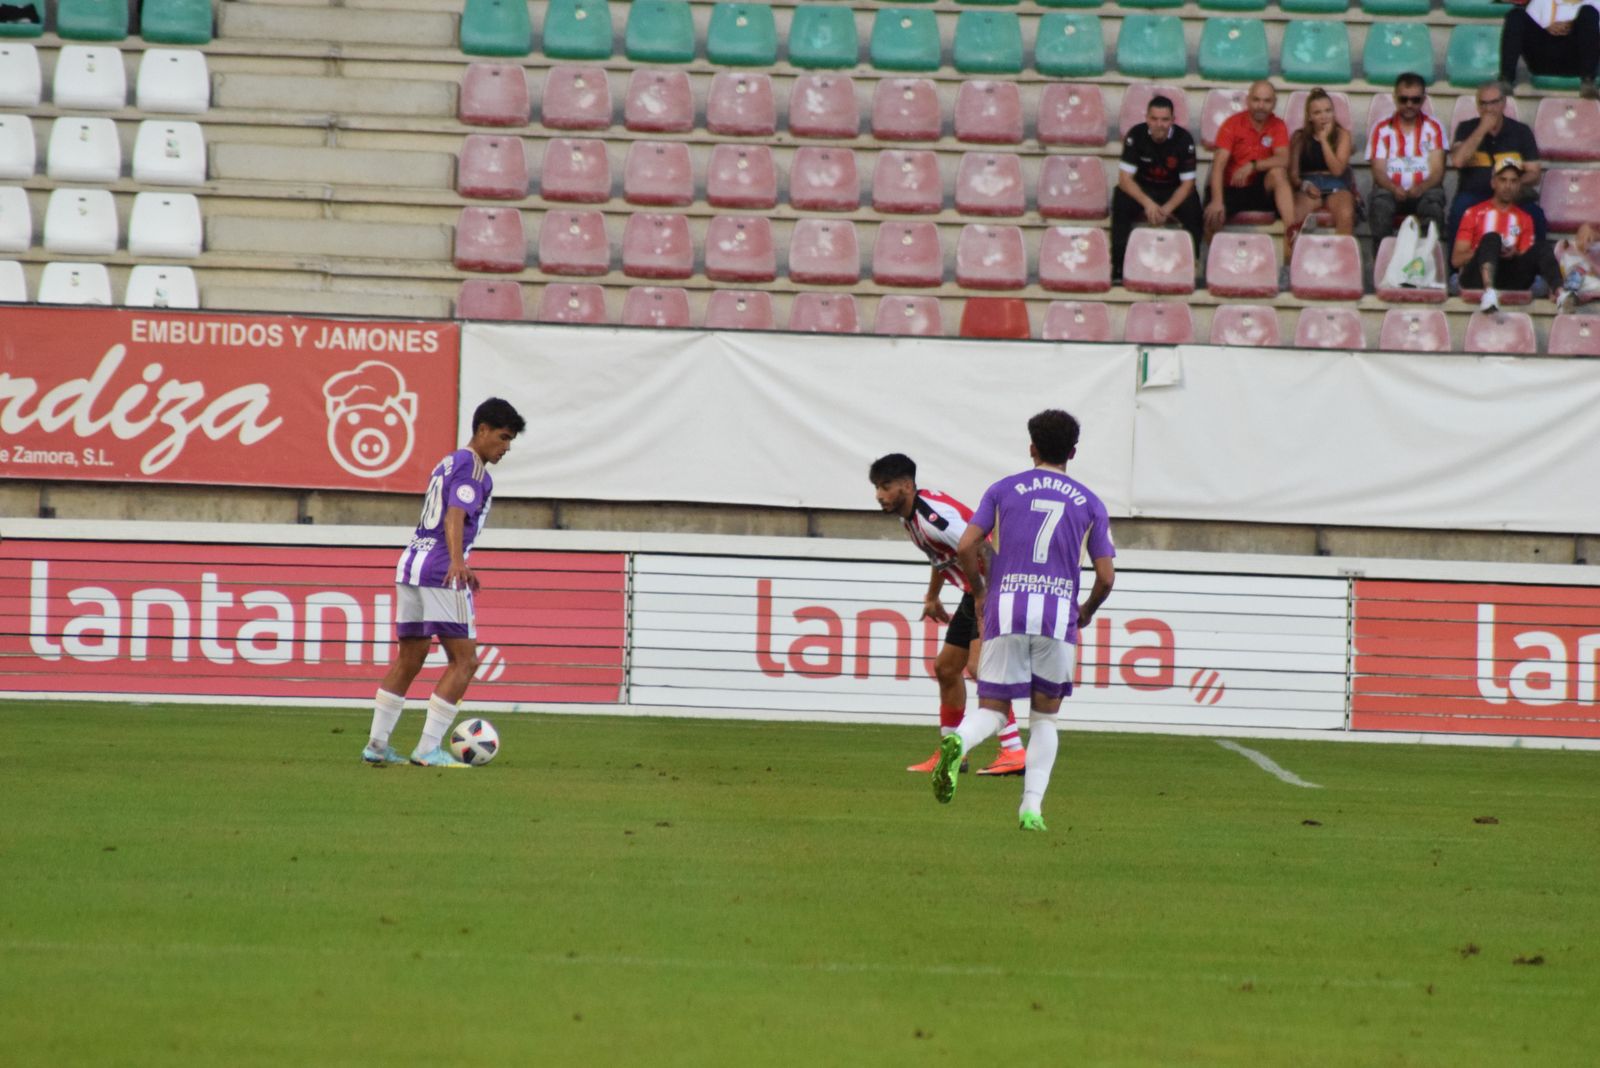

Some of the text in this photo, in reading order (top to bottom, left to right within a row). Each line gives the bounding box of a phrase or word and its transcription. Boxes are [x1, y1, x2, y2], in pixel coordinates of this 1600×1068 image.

[131, 319, 440, 354] EMBUTIDOS Y JAMONES
[12, 445, 79, 468] Zamora,
[83, 448, 114, 467] S.L.
[1014, 476, 1088, 507] R.ARROYO
[1030, 498, 1066, 565] 7
[999, 582, 1074, 599] NUTRITION
[1001, 573, 1075, 590] HERBALIFE
[28, 559, 450, 668] lantani
